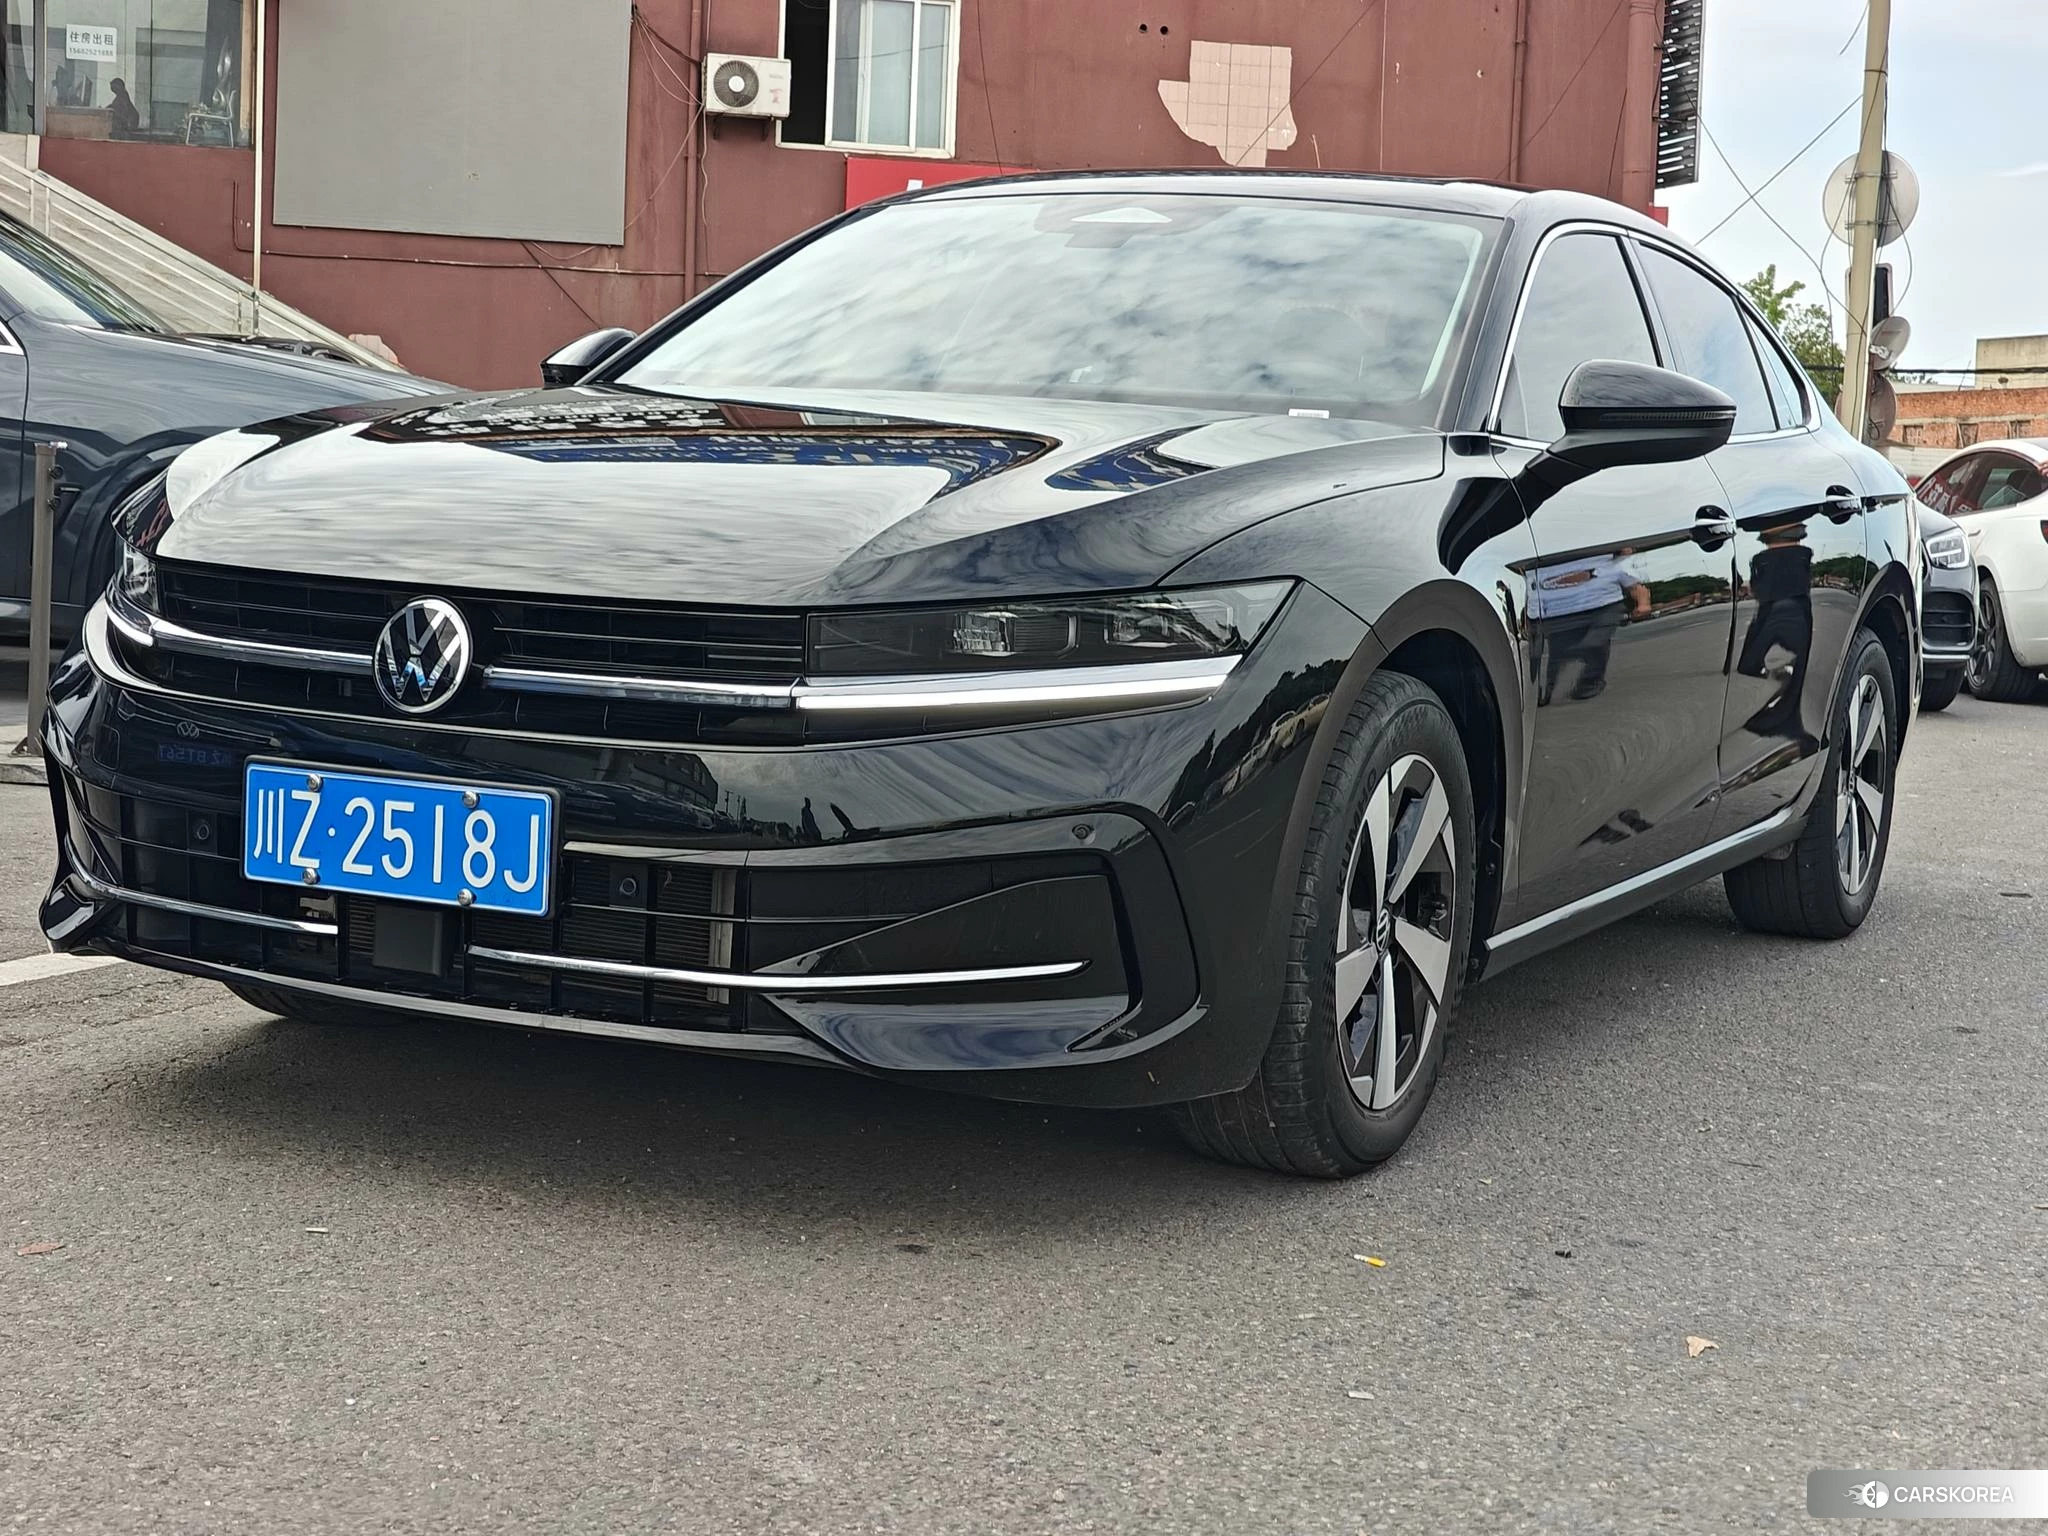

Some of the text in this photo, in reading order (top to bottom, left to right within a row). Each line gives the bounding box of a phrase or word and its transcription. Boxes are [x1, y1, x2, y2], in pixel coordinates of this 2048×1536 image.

[70, 32, 114, 46] 住房出租
[253, 788, 540, 893] 川Z·2518J
